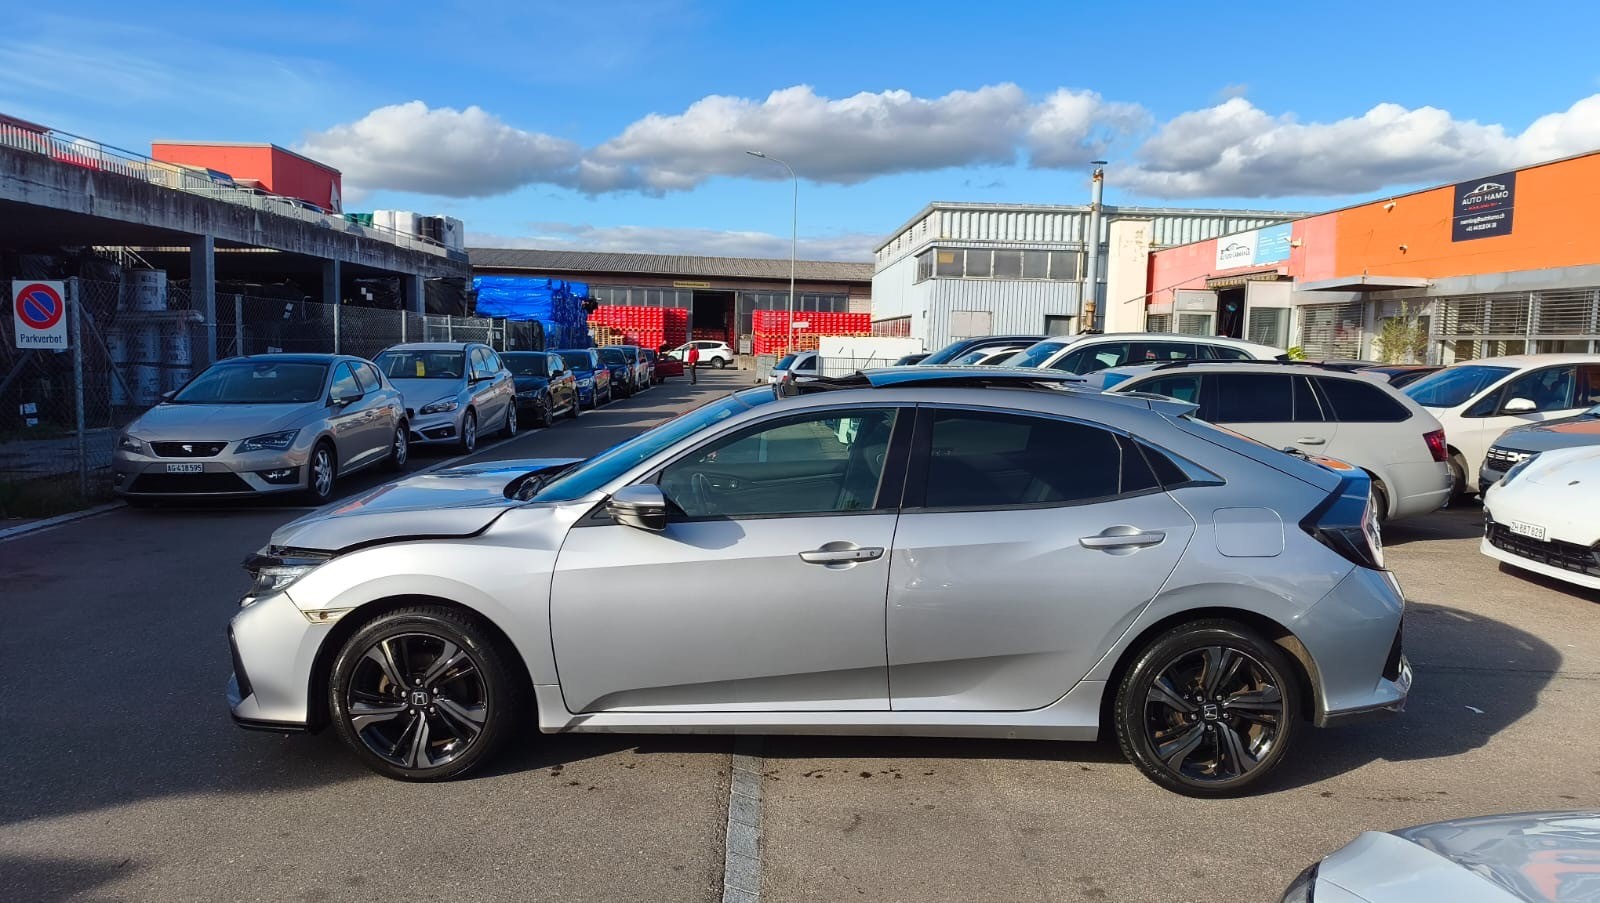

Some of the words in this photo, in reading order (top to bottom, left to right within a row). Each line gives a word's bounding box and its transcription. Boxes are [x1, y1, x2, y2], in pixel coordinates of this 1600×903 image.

[1462, 196, 1482, 205] AUTO
[1484, 191, 1509, 201] HAMO
[20, 333, 62, 344] Parkverbot
